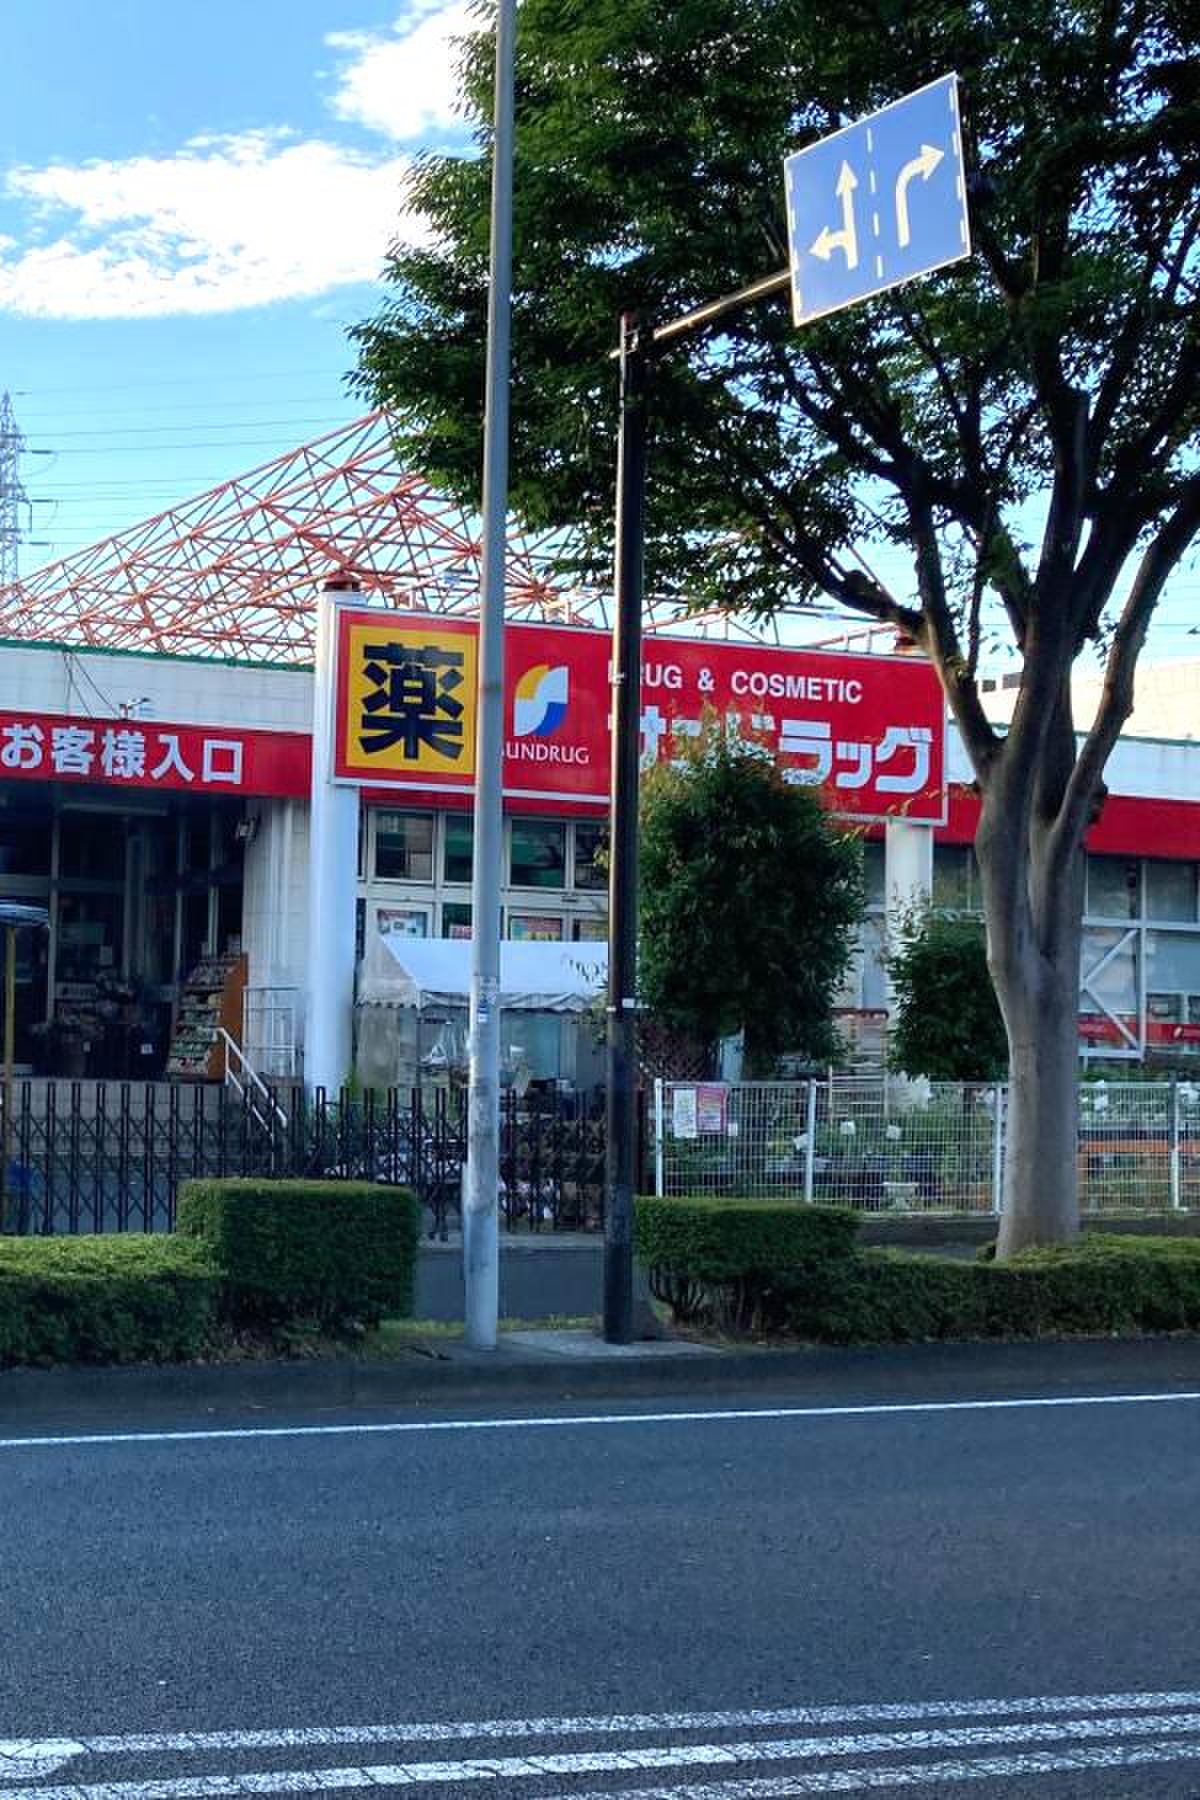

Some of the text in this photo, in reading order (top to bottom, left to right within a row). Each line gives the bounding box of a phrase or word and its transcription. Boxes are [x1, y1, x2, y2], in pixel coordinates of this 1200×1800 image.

[359, 642, 464, 760] 薬
[608, 660, 862, 704] UG & COSMETIC
[0, 723, 243, 785] お客様入口
[501, 740, 590, 765] UNDRUG
